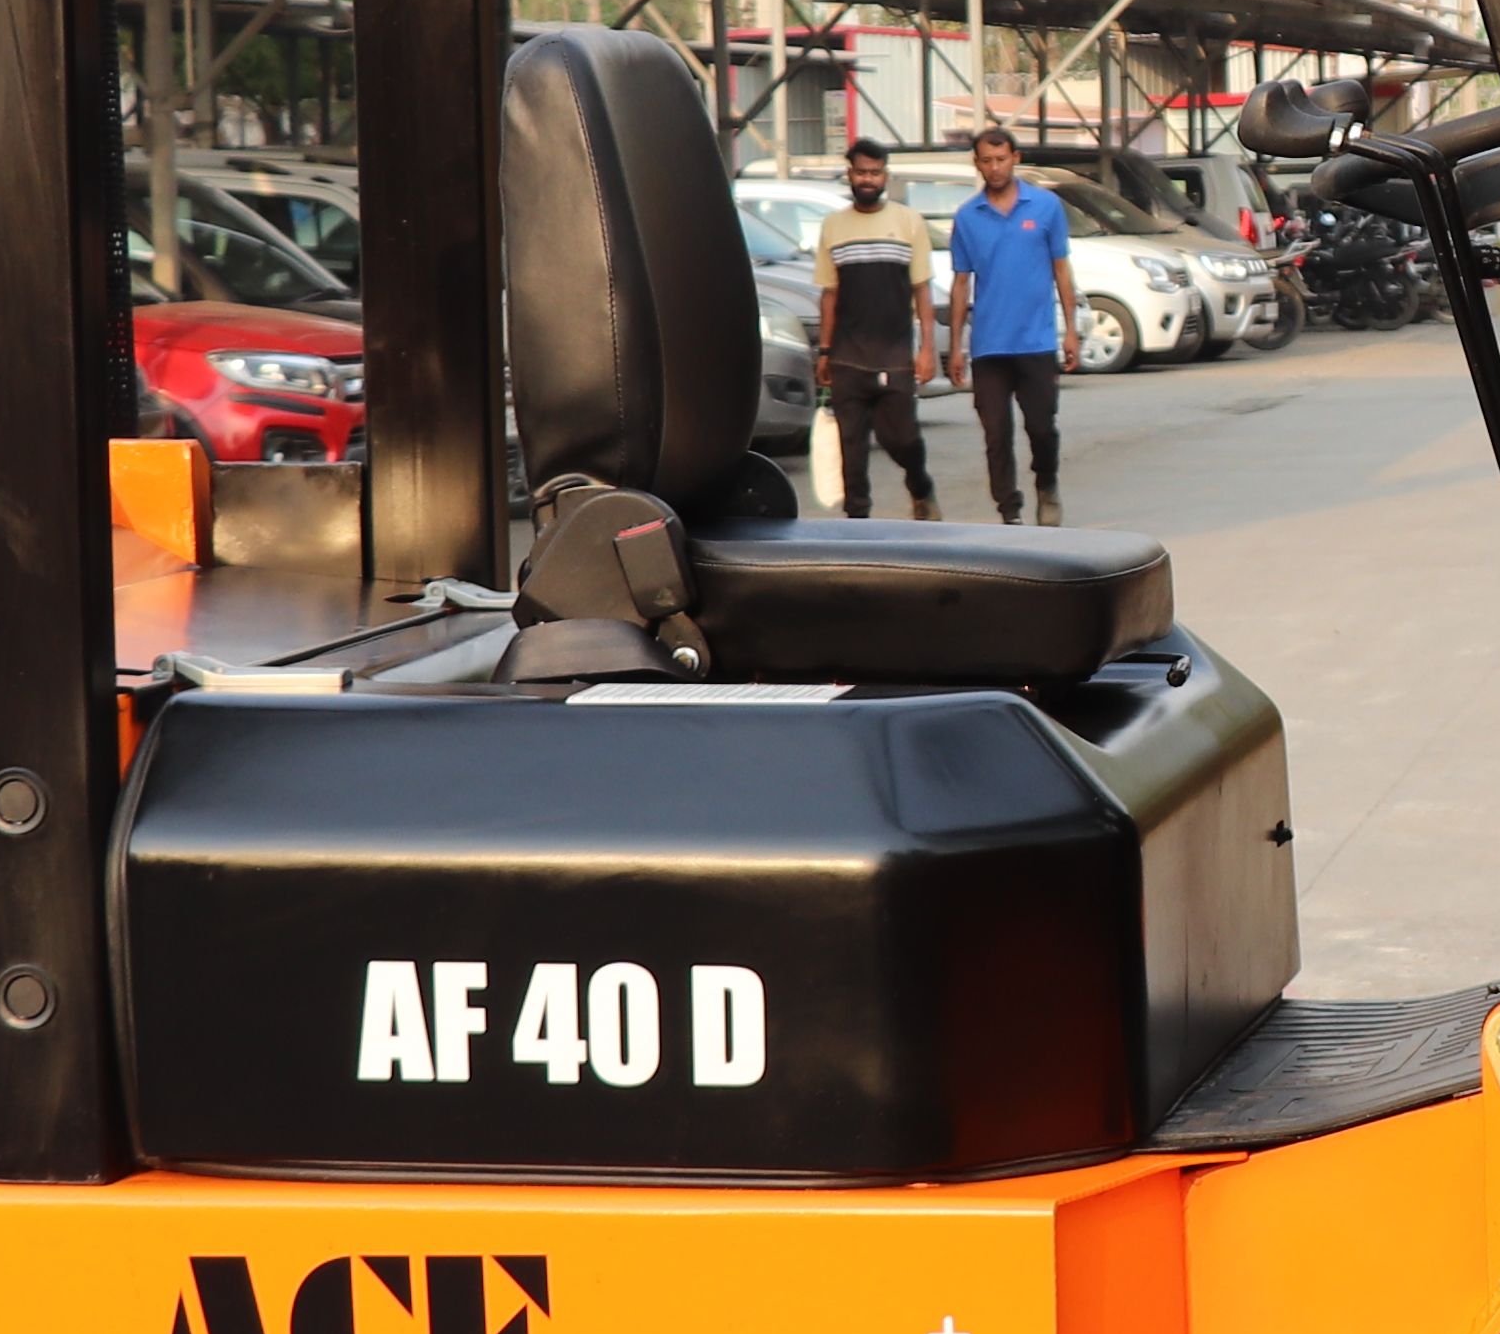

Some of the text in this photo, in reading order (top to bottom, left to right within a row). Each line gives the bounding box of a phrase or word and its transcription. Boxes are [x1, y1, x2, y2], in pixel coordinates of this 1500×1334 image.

[357, 960, 767, 1088] AF 40 D
